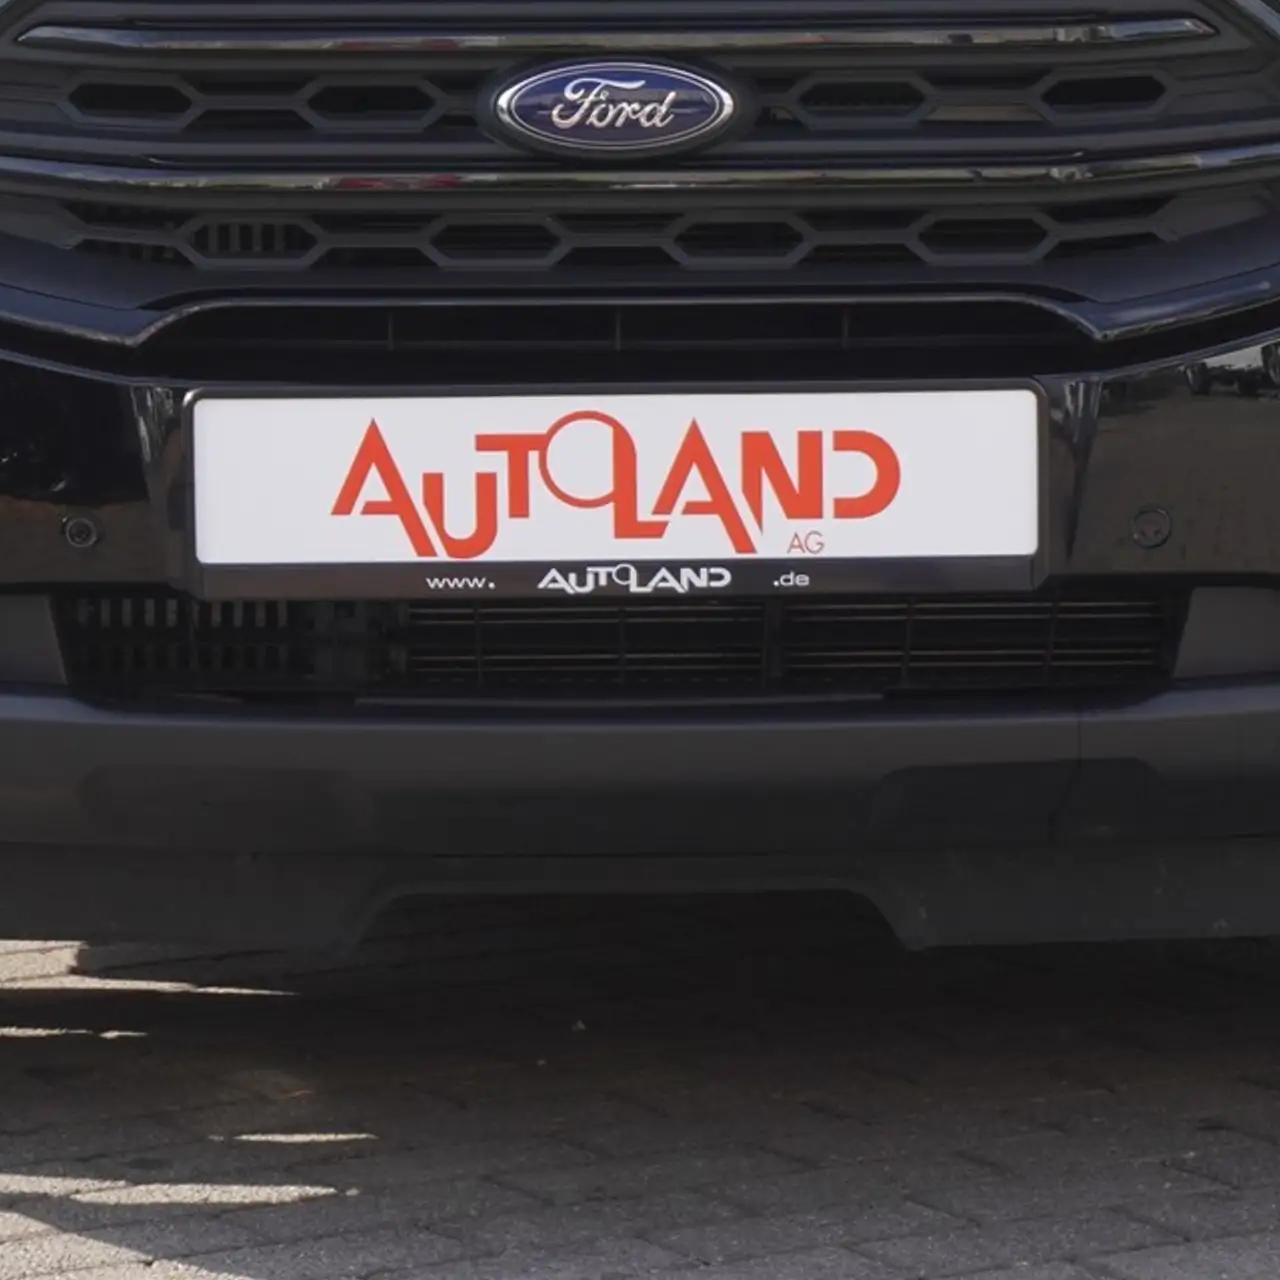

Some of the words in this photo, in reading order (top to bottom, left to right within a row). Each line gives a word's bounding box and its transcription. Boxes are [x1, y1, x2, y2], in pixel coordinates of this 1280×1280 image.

[550, 77, 677, 129] Ford
[786, 531, 826, 555] AG
[425, 575, 496, 590] www.
[772, 571, 810, 588] .de
